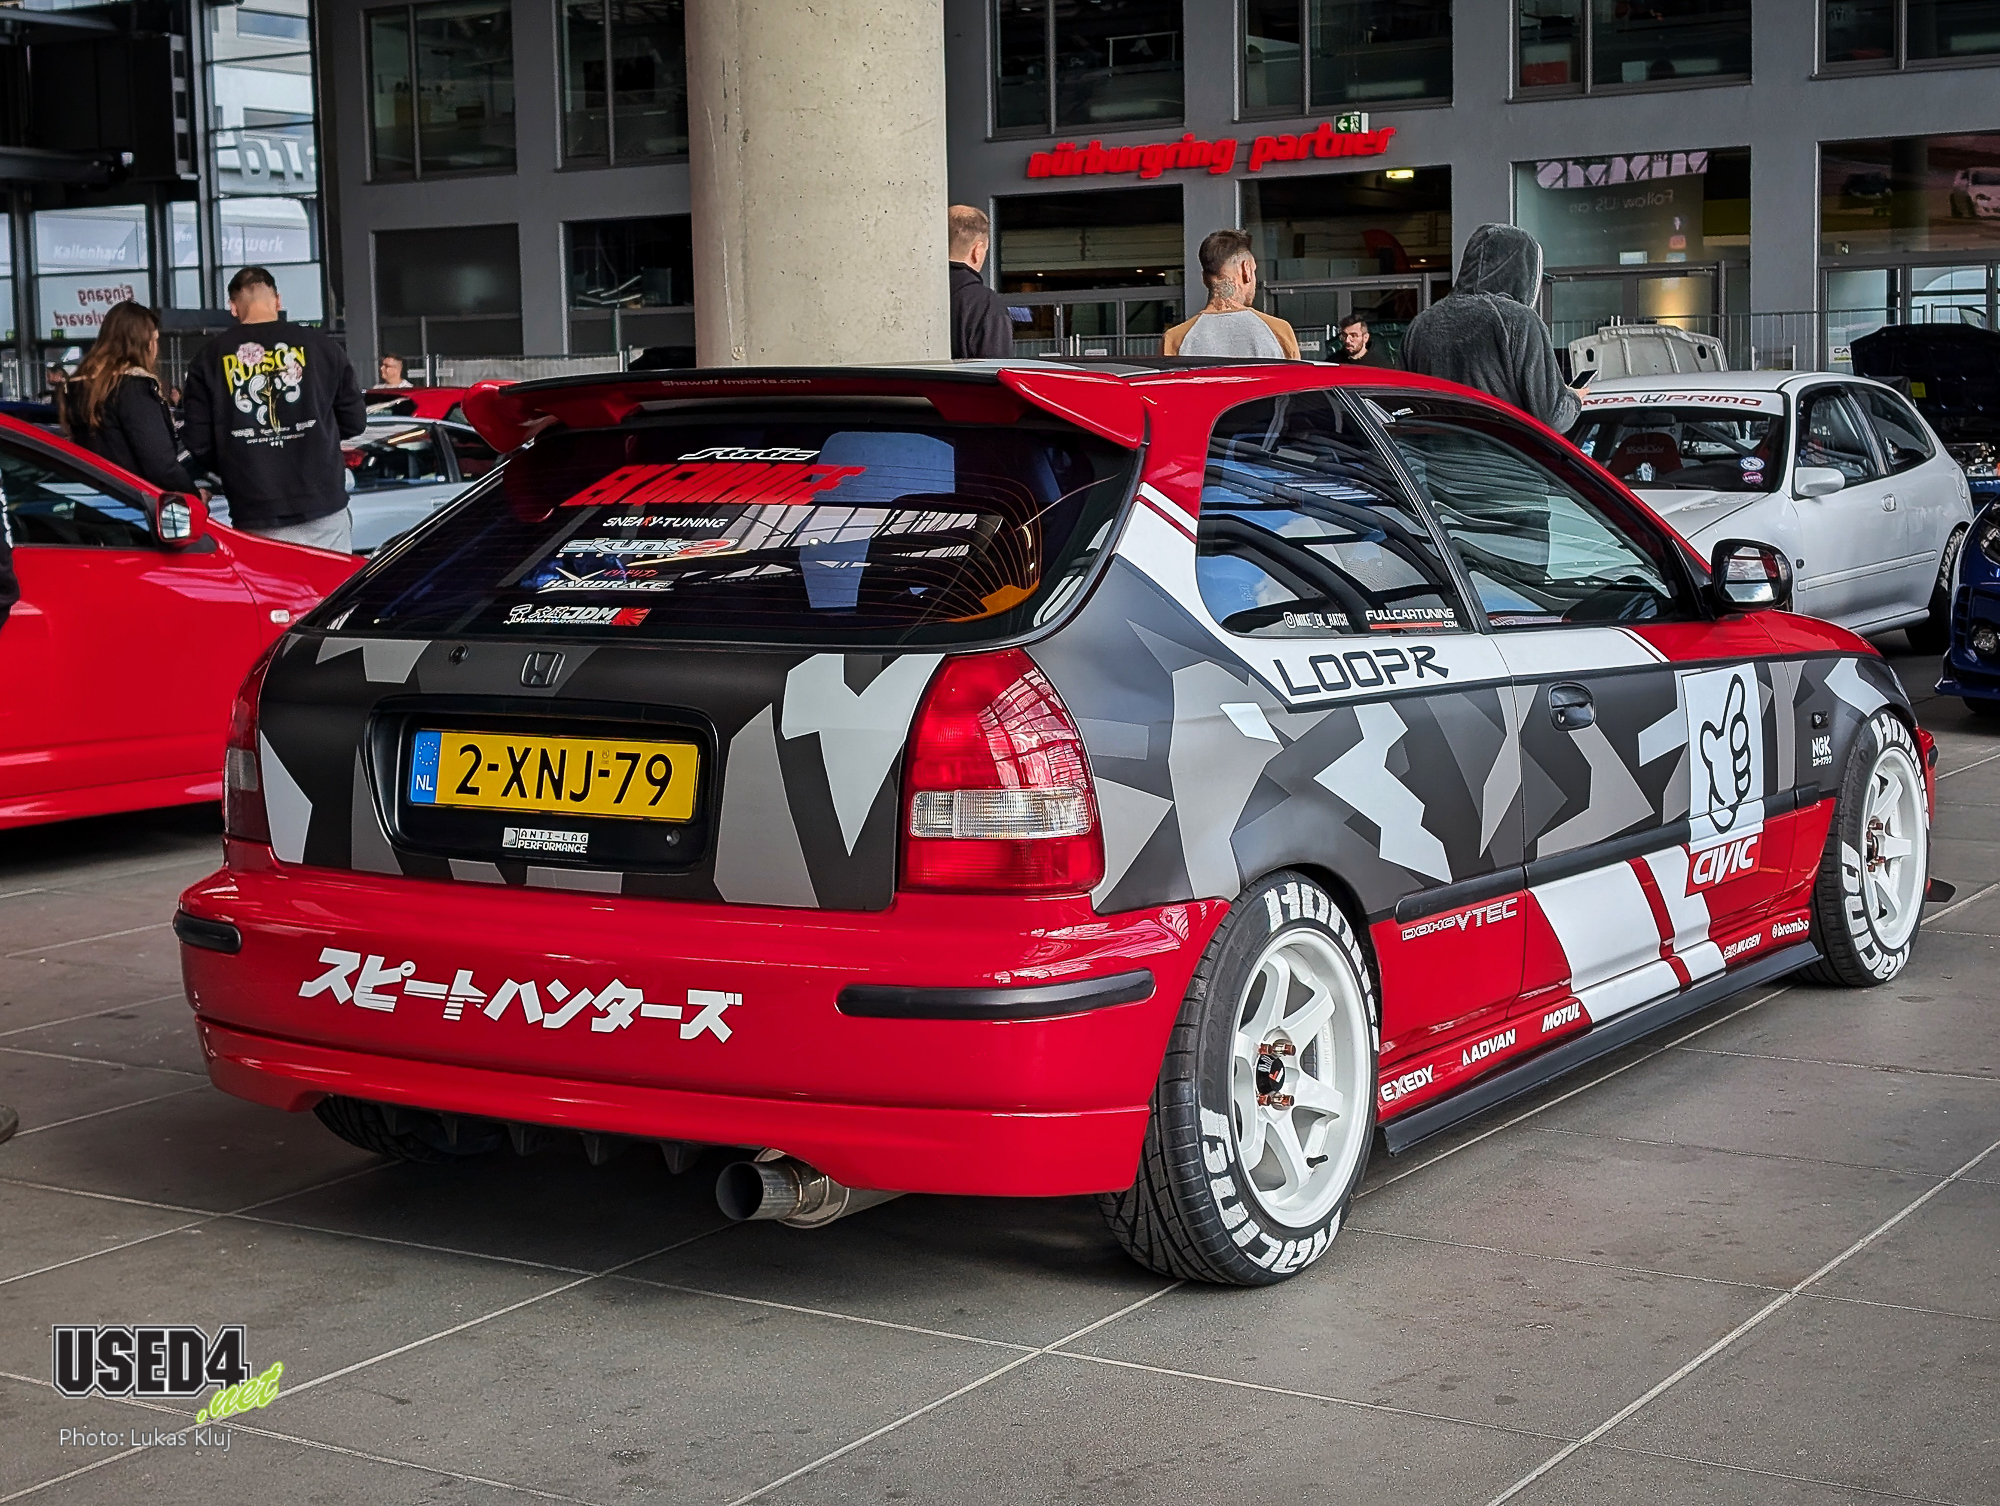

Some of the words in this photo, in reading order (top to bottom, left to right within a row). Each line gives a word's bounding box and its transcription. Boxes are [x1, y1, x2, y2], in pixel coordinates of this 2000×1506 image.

[1027, 133, 1238, 178] nürburgring
[1249, 122, 1396, 172] partner
[222, 235, 284, 256] ergwerk
[1582, 396, 1636, 406] NDA
[1666, 394, 1763, 407] PRIMO
[602, 516, 729, 528] SNEAKY-TUNING
[541, 580, 675, 590] HARDRACE
[1366, 608, 1455, 620] FULLCARTUNING
[1273, 645, 1449, 696] LOOPR
[1812, 735, 1831, 758] NGK
[415, 774, 434, 791] NL
[455, 743, 674, 806] 2-XNJ-79
[518, 840, 588, 853] PERFORMANCE
[520, 830, 587, 843] ANTI-LAG
[1693, 836, 1758, 884] CIVIC
[1454, 898, 1518, 931] VTEC
[1777, 917, 1810, 937] brembo
[1737, 932, 1762, 954] MUGEN
[1542, 1002, 1581, 1033] MOTUL
[1470, 1029, 1516, 1063] ADVAN
[1380, 1064, 1434, 1102] EXEDY
